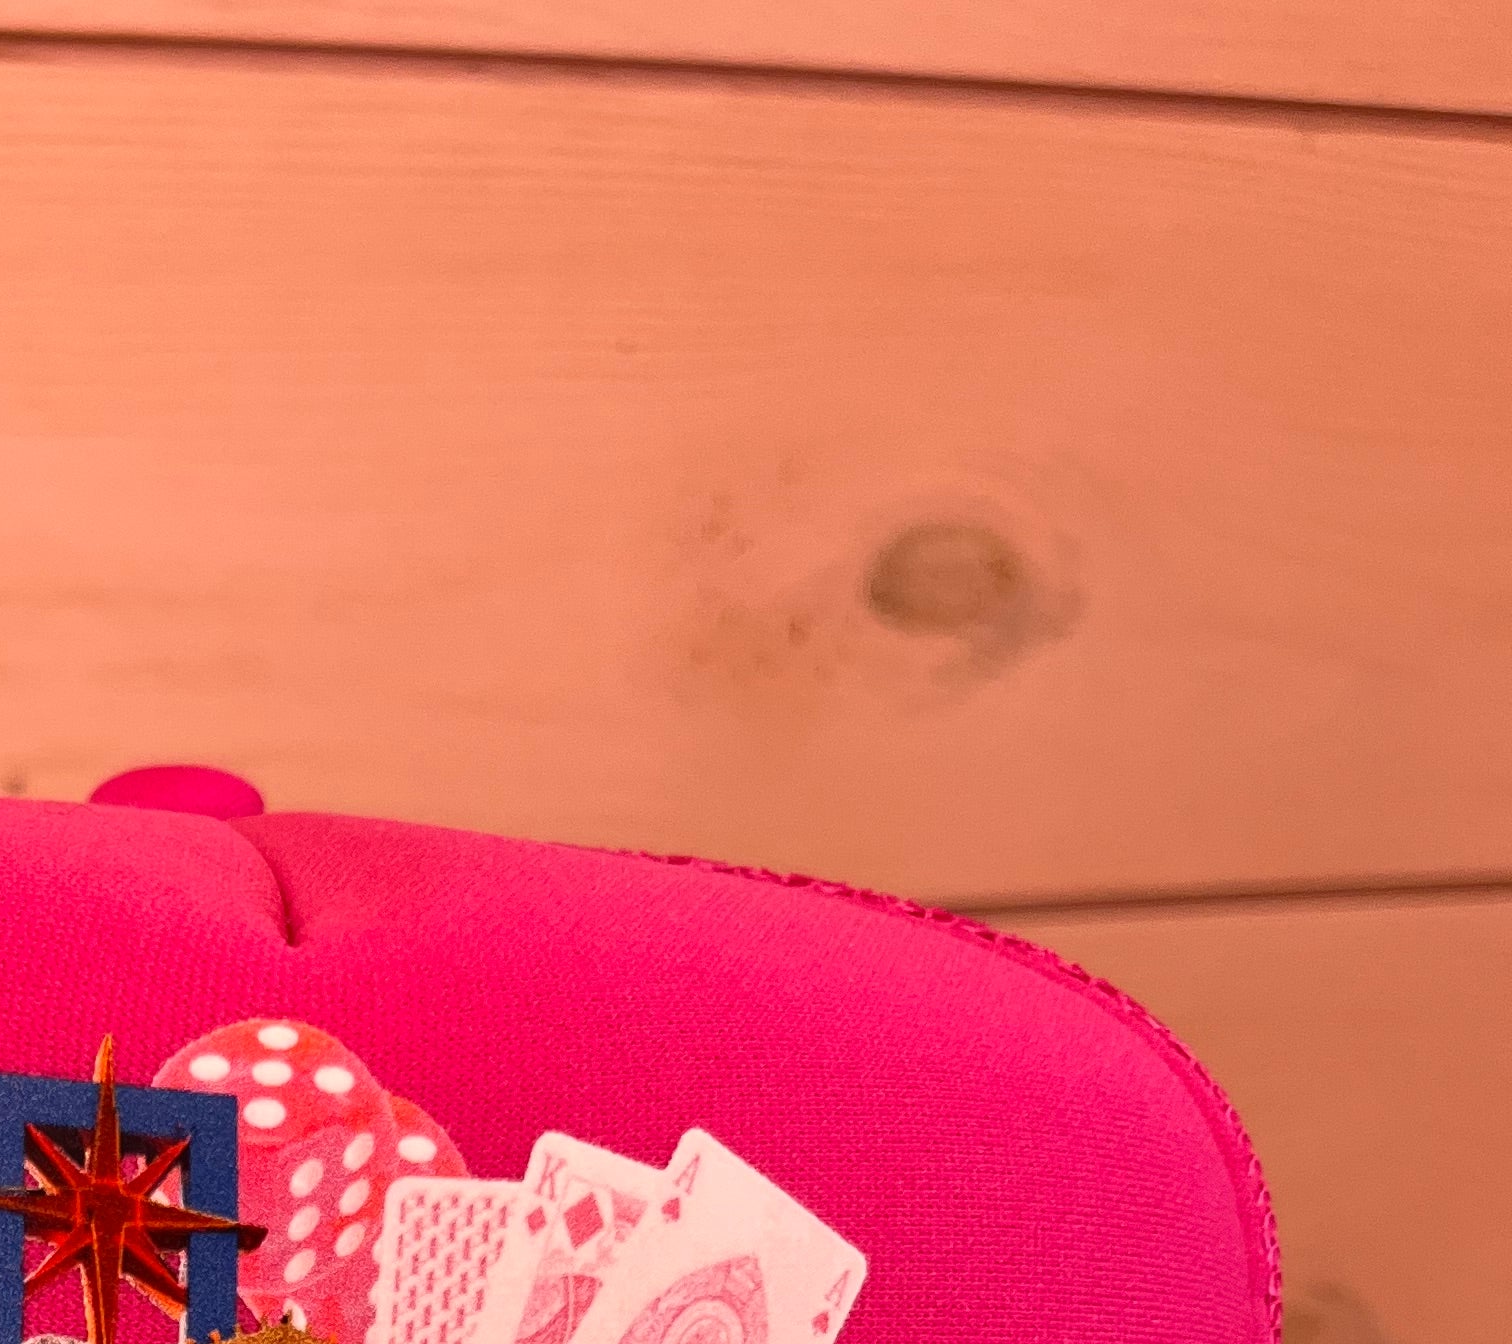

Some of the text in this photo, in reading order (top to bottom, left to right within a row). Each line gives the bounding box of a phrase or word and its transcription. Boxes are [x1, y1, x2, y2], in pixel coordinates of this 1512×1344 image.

[536, 1154, 567, 1200] K
[674, 1154, 701, 1195] A
[824, 1269, 852, 1311] A
